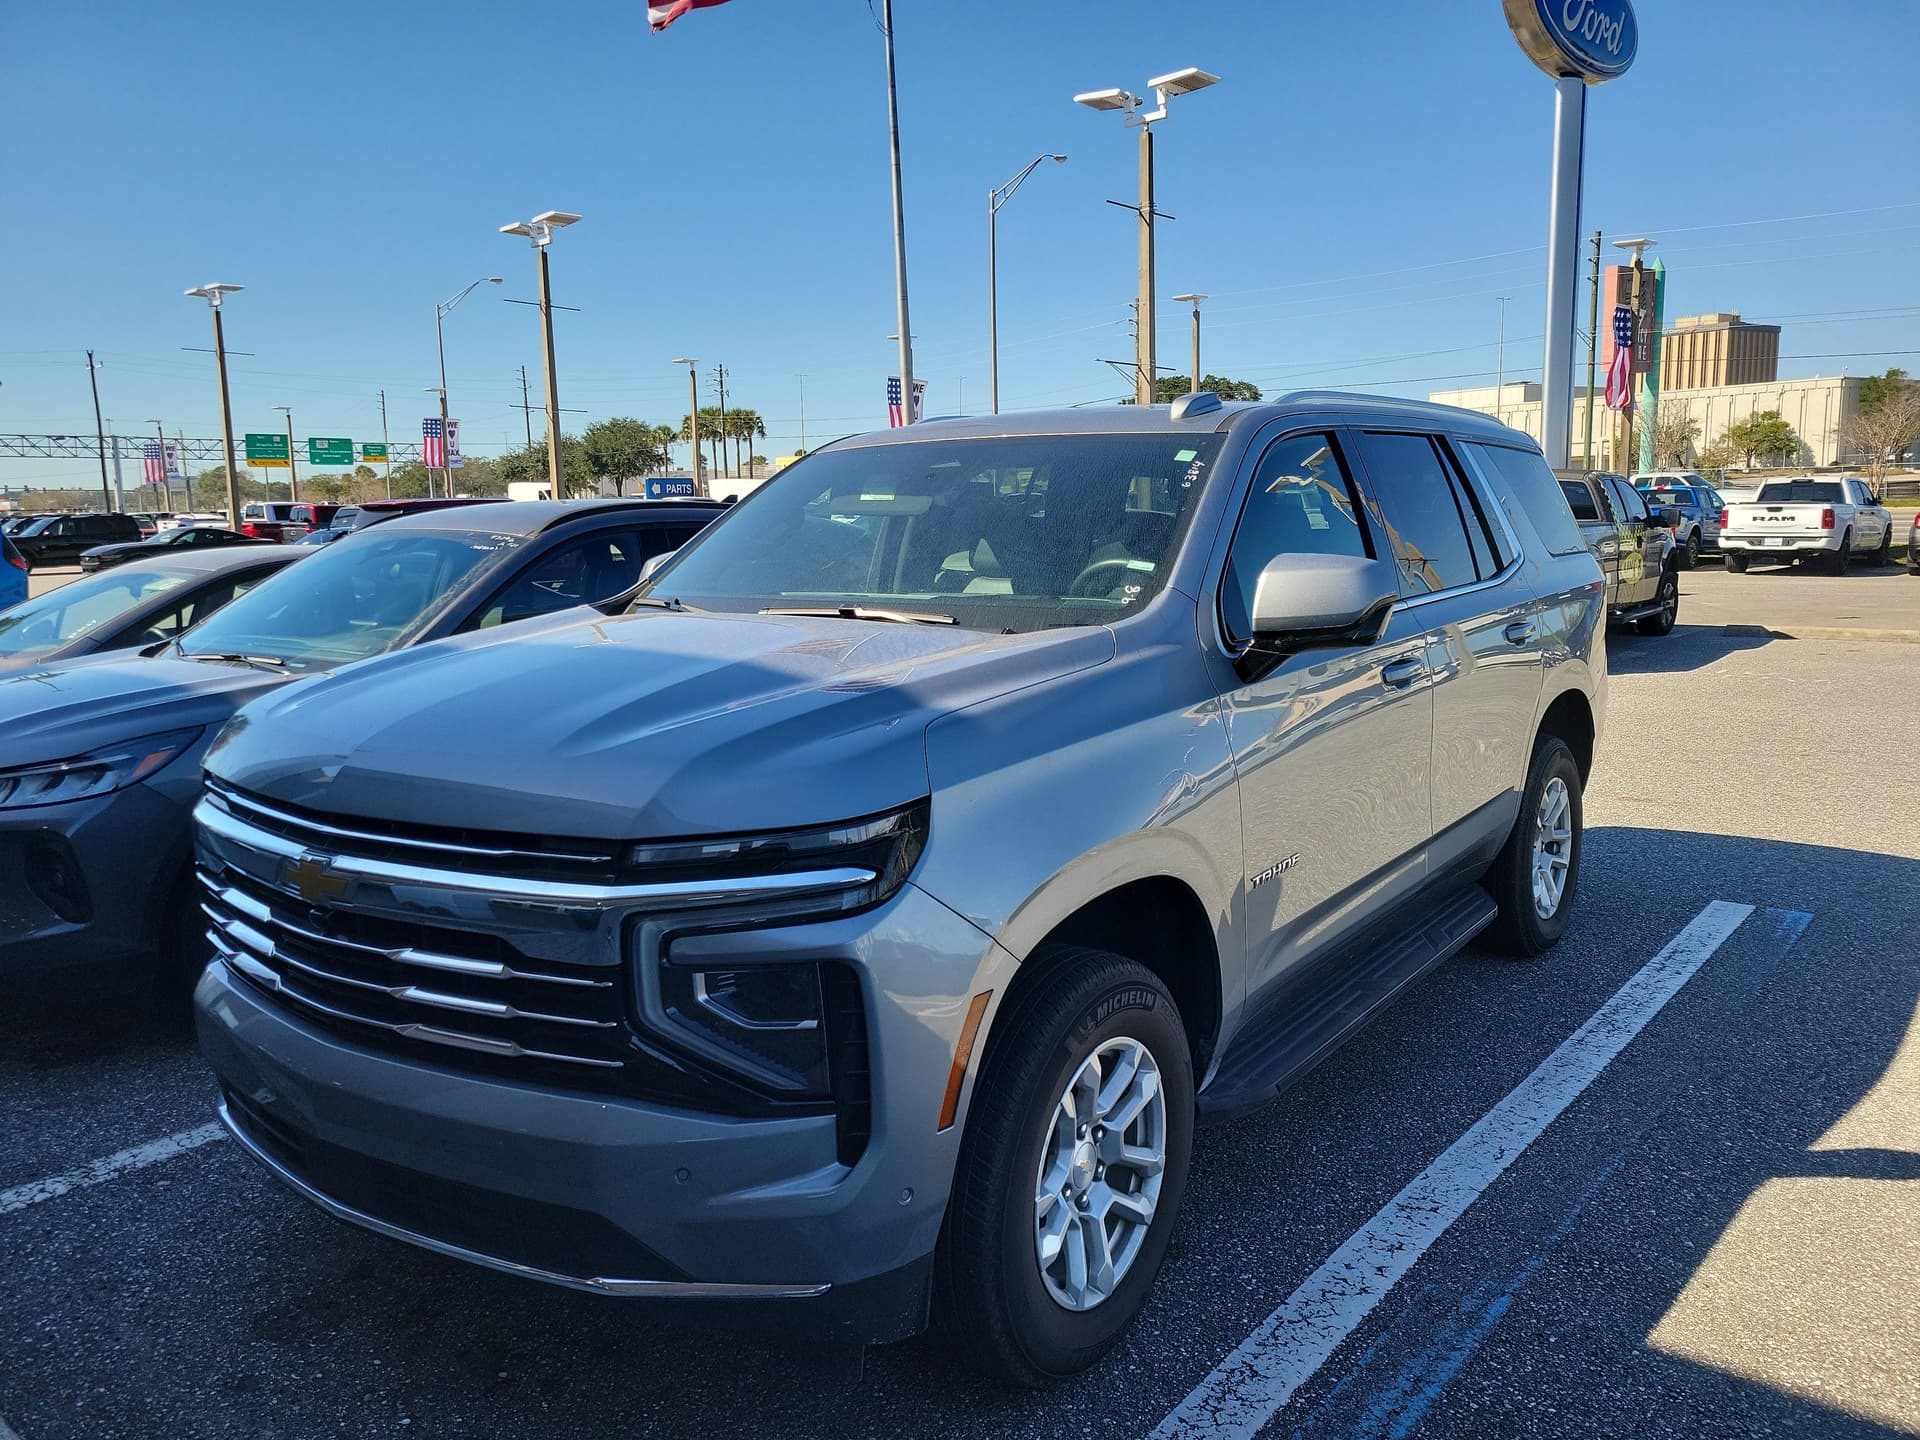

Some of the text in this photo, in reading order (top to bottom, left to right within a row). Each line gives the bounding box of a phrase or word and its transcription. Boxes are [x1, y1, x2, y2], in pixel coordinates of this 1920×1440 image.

[912, 383, 925, 393] WE
[666, 484, 692, 494] PARTS
[1250, 852, 1300, 888] TAHOE
[1097, 990, 1155, 1022] MICHELIN
